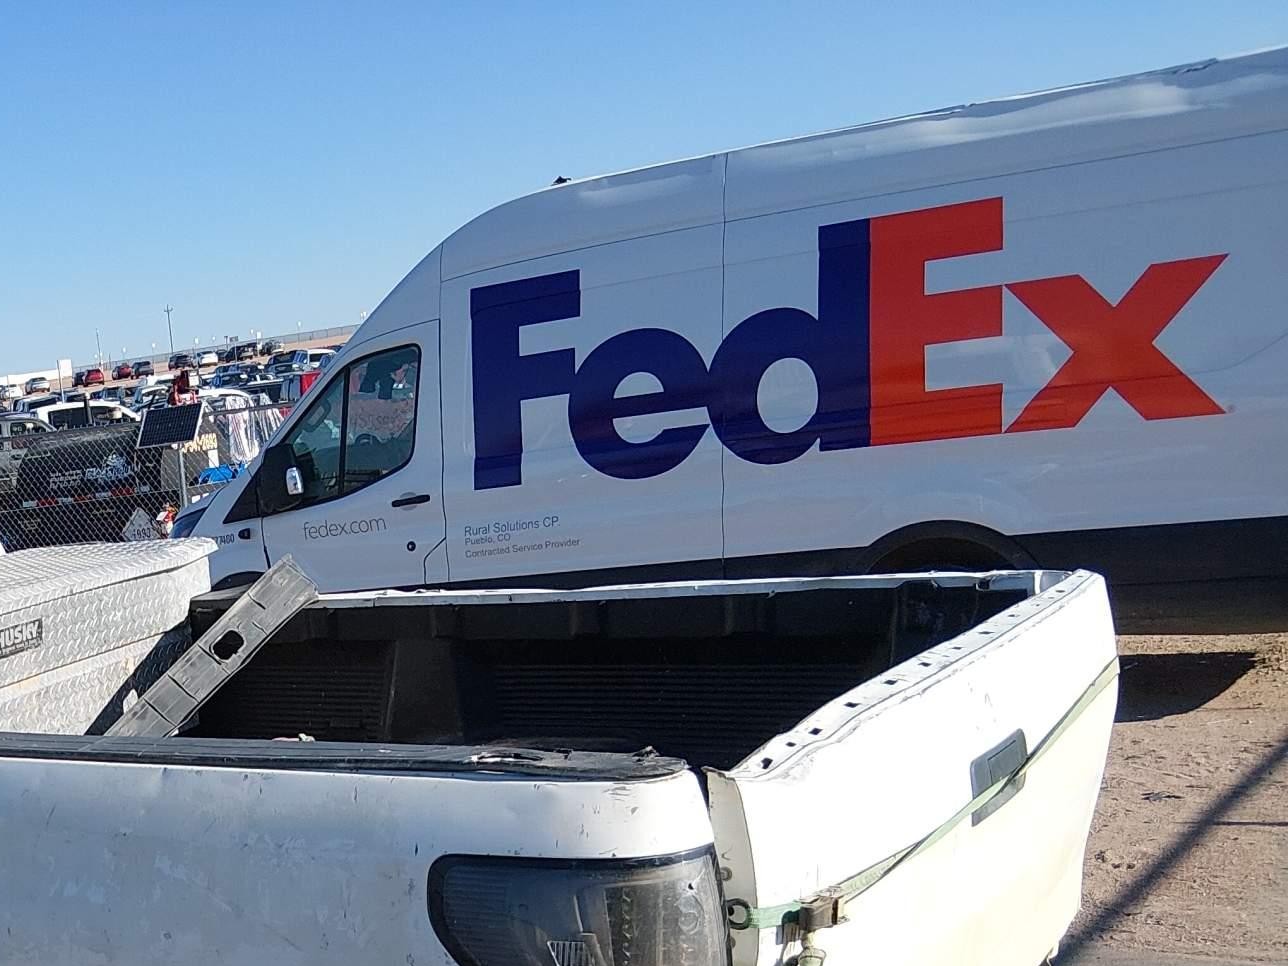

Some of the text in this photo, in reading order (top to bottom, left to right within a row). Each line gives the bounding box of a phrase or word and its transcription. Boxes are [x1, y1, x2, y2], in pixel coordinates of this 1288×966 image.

[470, 197, 1229, 490] FedEx
[303, 516, 387, 540] fedex.com
[464, 524, 490, 537] Rural
[493, 519, 540, 534] Solutions
[497, 533, 511, 542] CO
[465, 538, 581, 559] Contracted Service Provider
